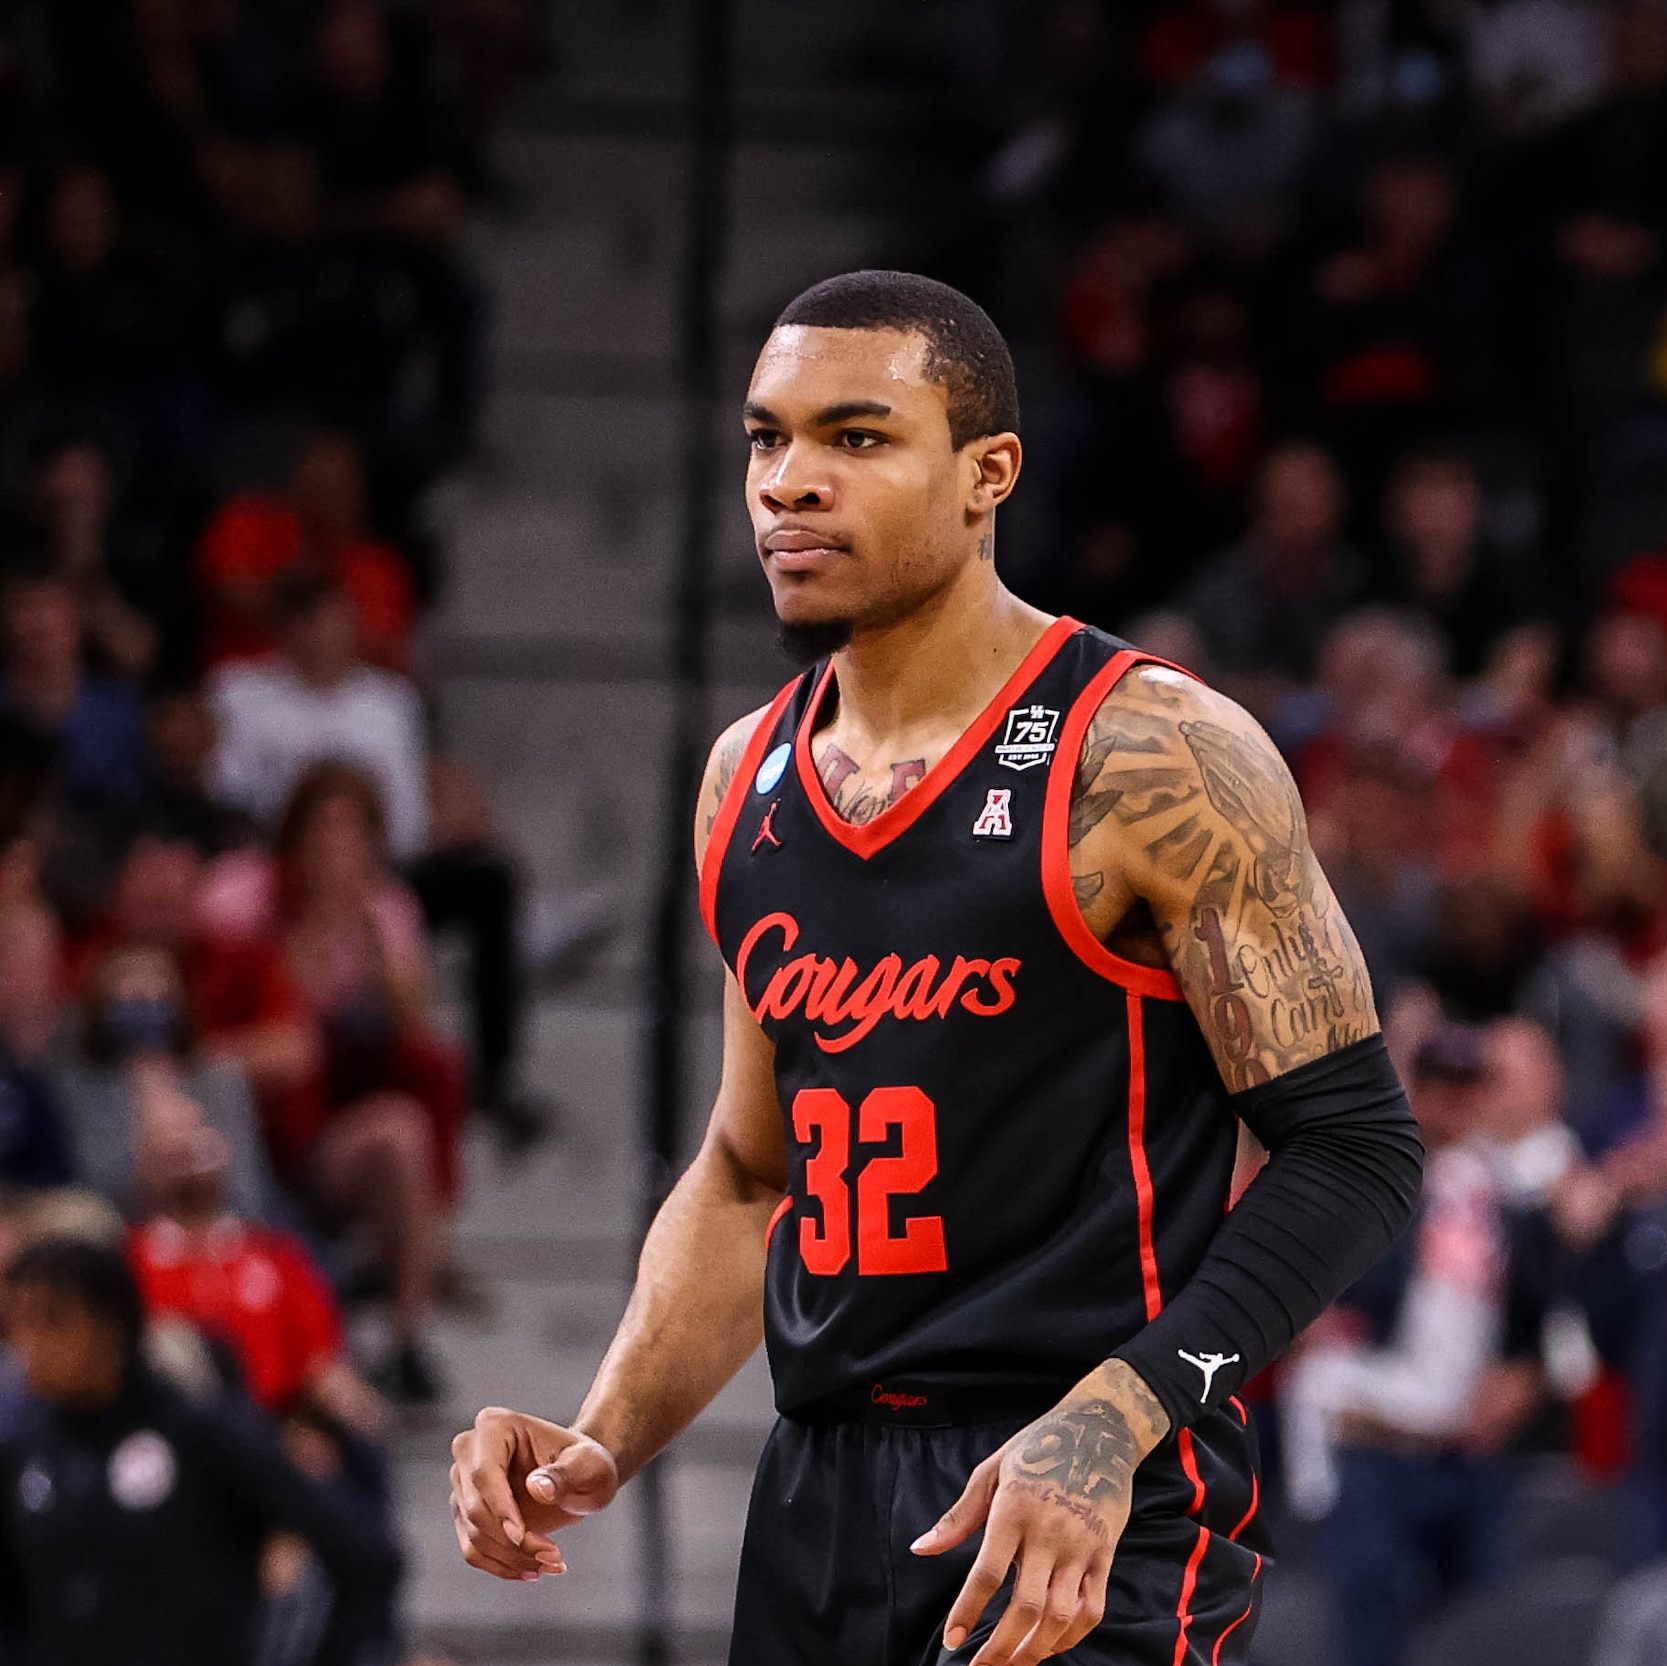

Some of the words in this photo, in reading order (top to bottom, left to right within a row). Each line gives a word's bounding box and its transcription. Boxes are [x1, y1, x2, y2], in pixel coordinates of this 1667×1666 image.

[1013, 721, 1048, 743] 75
[736, 911, 1021, 1053] Cougars
[792, 1086, 948, 1276] 32
[871, 1383, 927, 1411] Cougars
